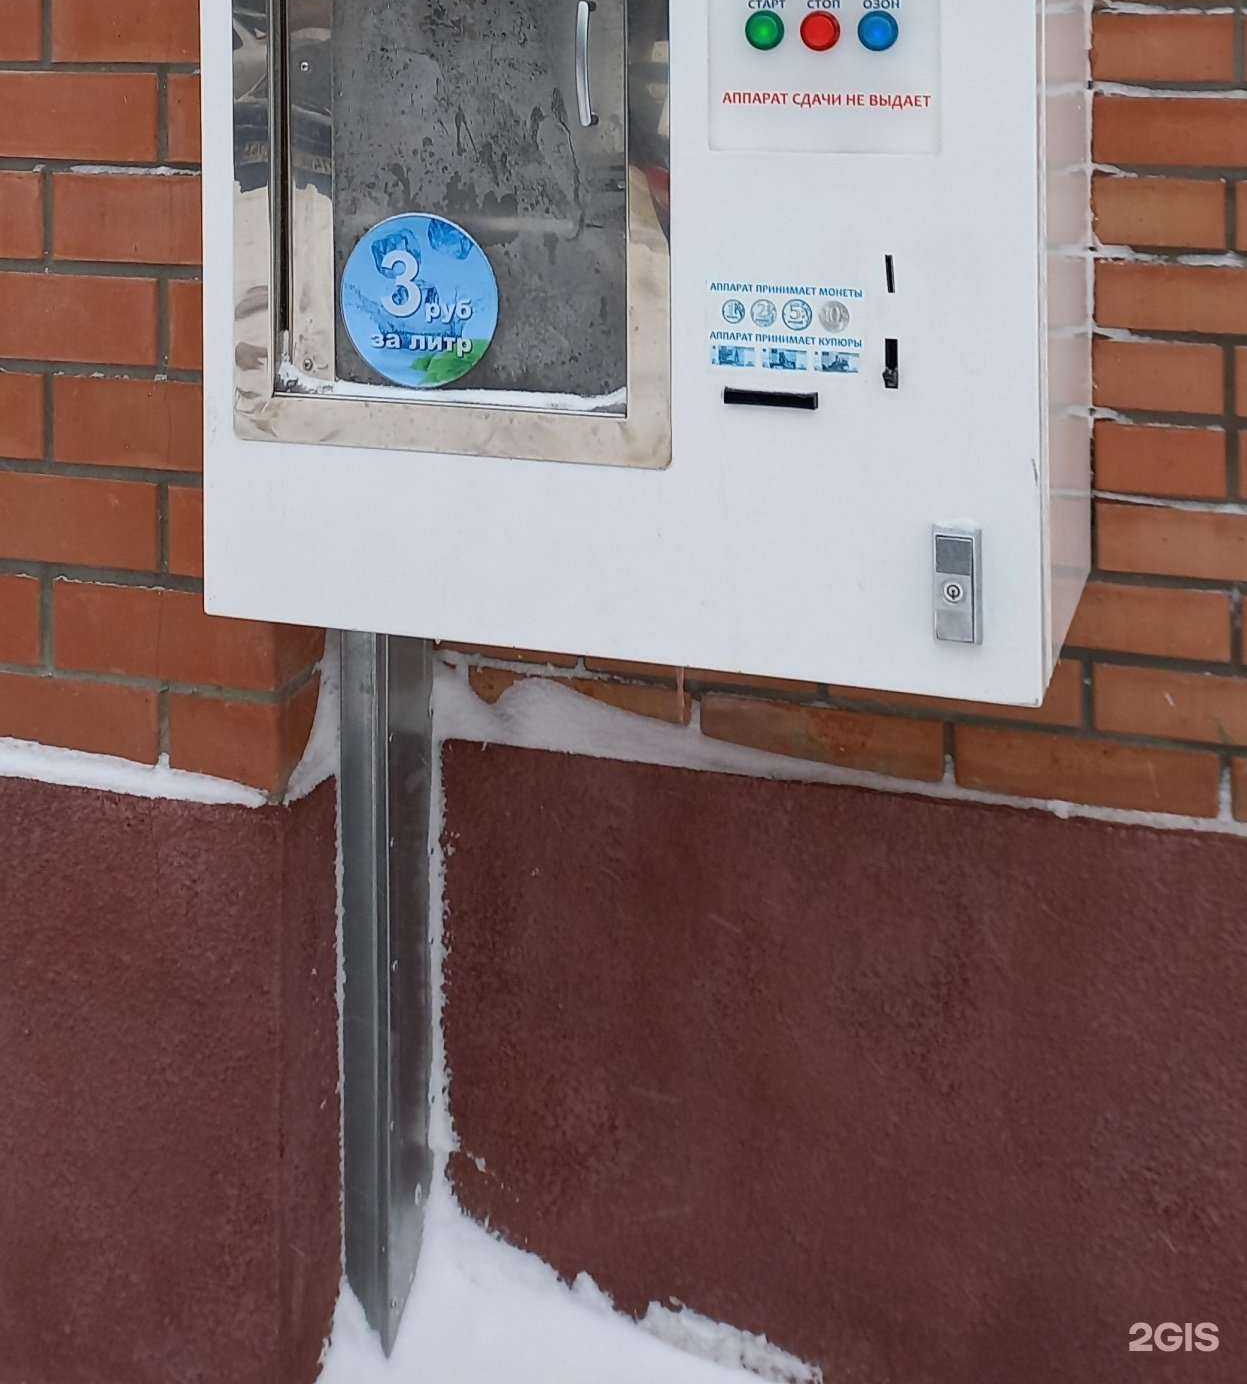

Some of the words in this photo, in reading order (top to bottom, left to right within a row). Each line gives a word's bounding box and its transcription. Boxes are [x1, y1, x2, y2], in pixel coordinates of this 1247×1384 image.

[748, 0, 786, 9] СТАРТ
[806, 0, 841, 9] СТОП
[863, 0, 900, 9] ОЗОН
[722, 92, 788, 105] АППАРАТ
[792, 93, 841, 108] СДАЧИ
[846, 94, 865, 106] НЕ
[869, 94, 931, 109] ВЫДАЕТ
[380, 250, 422, 318] 3
[424, 297, 473, 323] руб
[709, 282, 753, 292] АППАРАТ
[755, 284, 816, 296] ПРИНИМАЕТ
[819, 287, 863, 298] МОНЕТЫ
[371, 332, 401, 348] за
[408, 333, 472, 357] литр
[709, 331, 753, 342] АППАРАТ
[755, 333, 816, 346] ПРИНИМАЕТ
[819, 336, 863, 348] КУПЮРЫ
